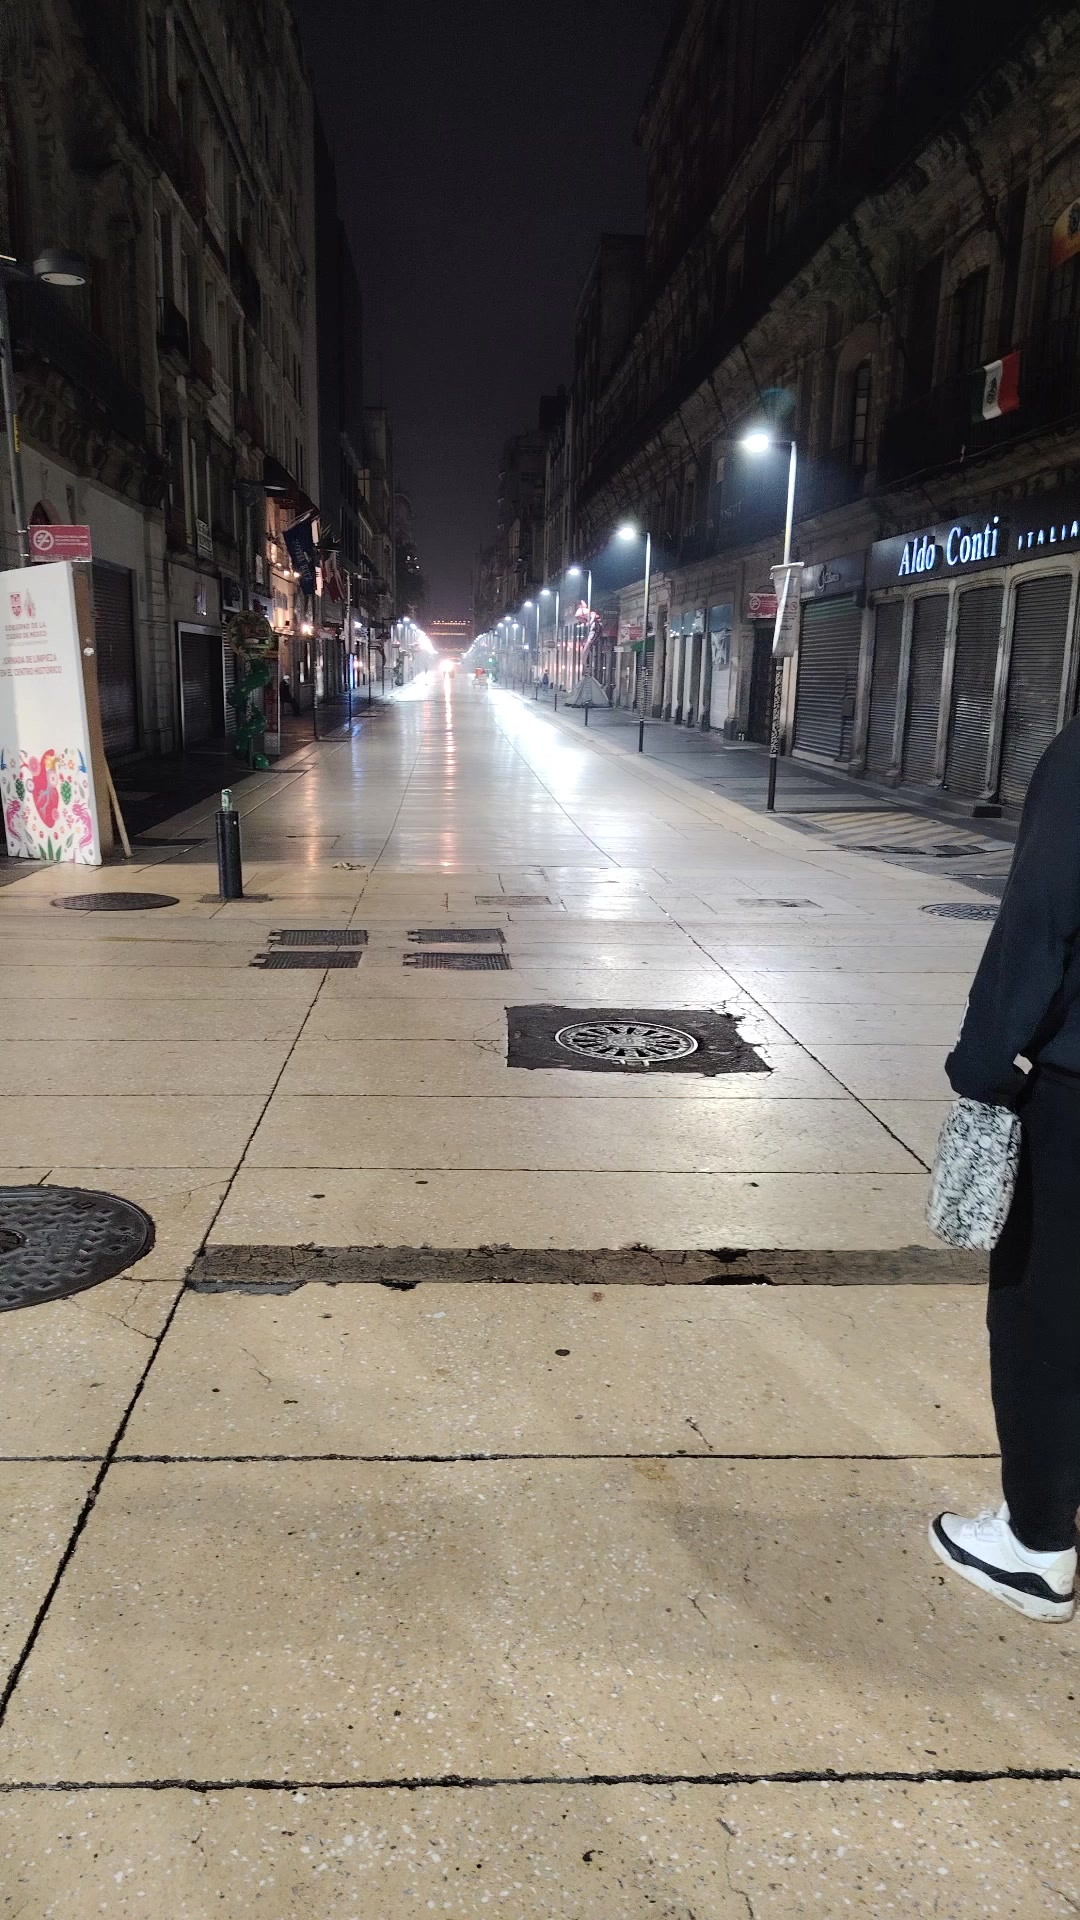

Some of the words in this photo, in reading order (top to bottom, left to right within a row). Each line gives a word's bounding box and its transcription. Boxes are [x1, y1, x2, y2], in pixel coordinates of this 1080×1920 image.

[898, 535, 937, 577] Aldo
[946, 516, 1000, 566] Conti
[1017, 520, 1080, 551] ITALIA
